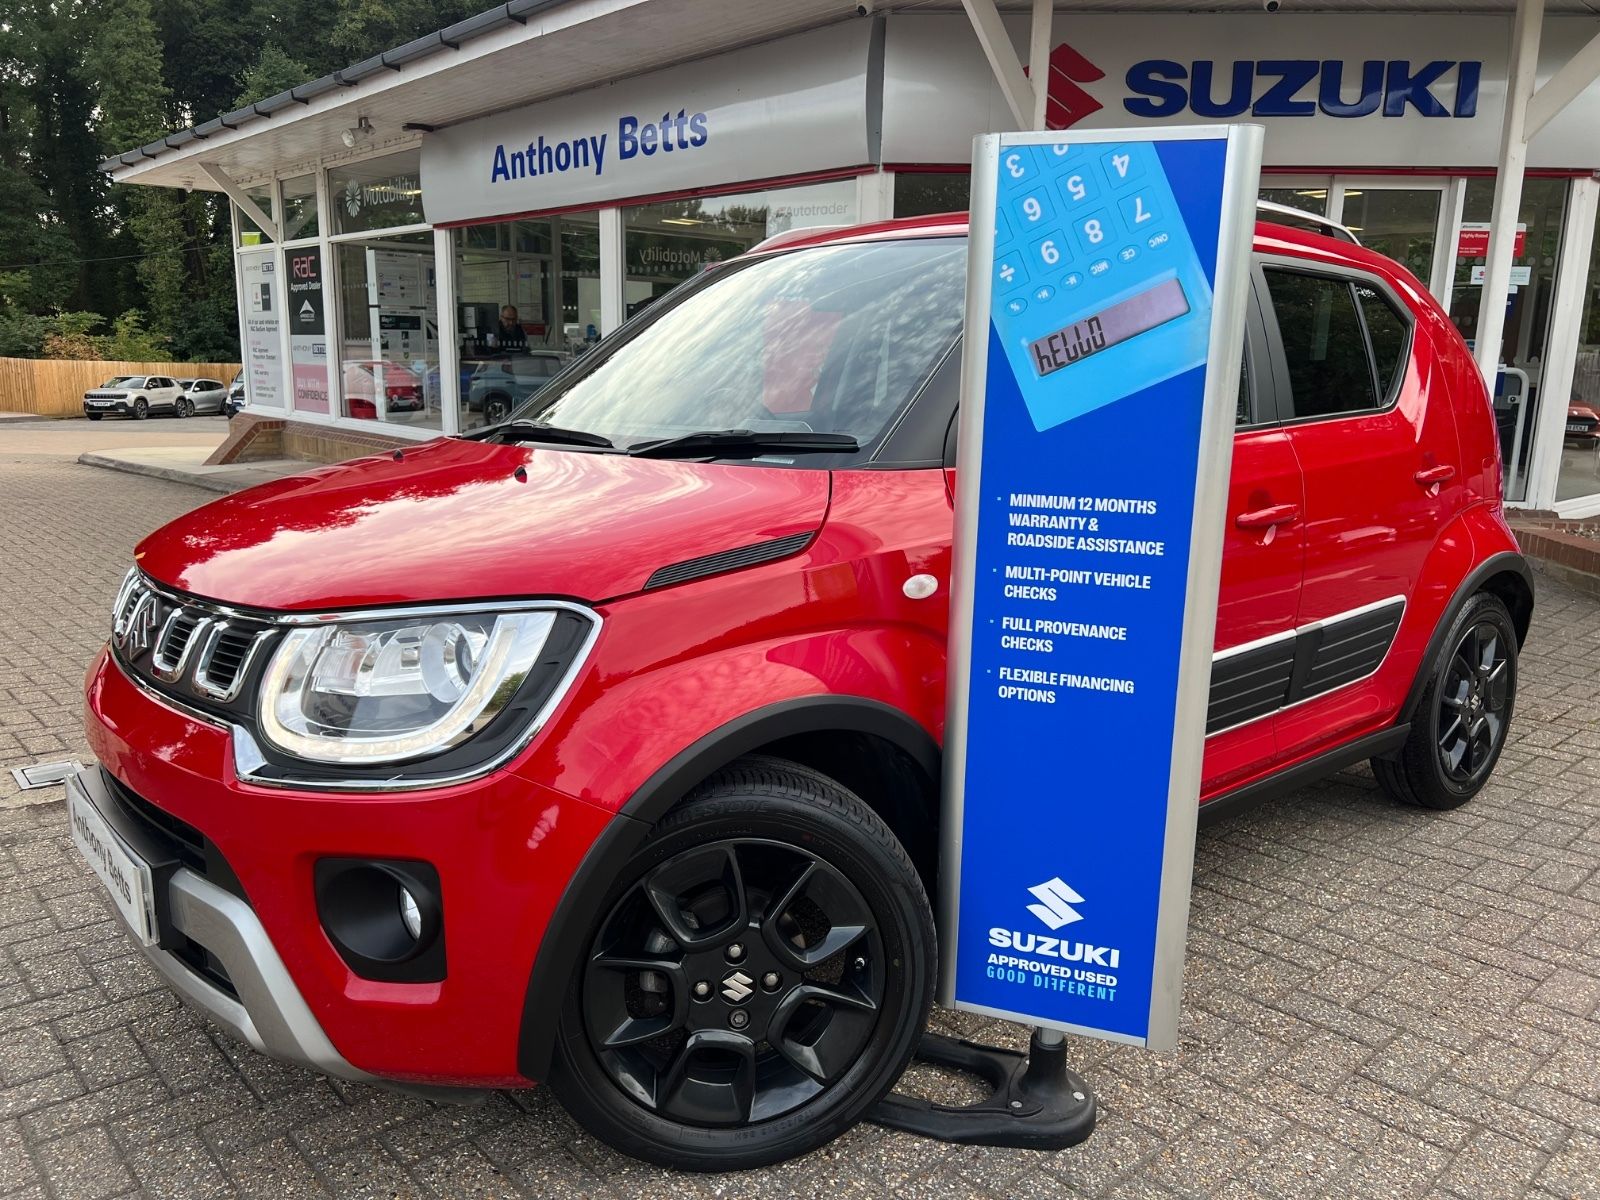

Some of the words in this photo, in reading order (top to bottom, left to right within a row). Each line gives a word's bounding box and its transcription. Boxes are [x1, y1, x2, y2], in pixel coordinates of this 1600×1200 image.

[1123, 59, 1482, 119] SUZUKI
[492, 134, 607, 183] Anthony
[619, 108, 708, 161] Betts
[1006, 154, 1024, 178] 3
[1112, 154, 1130, 178] 4
[363, 176, 417, 207] Motability
[1067, 175, 1086, 201] 5
[785, 201, 849, 217] Autotrader
[1023, 197, 1042, 221] 6
[1135, 197, 1151, 224] 7
[1084, 219, 1104, 244] 8
[1010, 493, 1076, 510] MINIMUM
[1078, 497, 1092, 510] 12
[1094, 498, 1156, 514] MONTHS
[1009, 513, 1086, 530] WARRANTY
[1088, 518, 1099, 532] &
[1008, 532, 1075, 550] ROADSIDE
[1076, 537, 1164, 556] ASSISTANCE
[1006, 565, 1092, 584] MULTI-POINT
[1094, 572, 1151, 589] VEHICLE
[1004, 585, 1056, 602] CHECKS
[1002, 616, 1033, 632] FULL
[1035, 620, 1127, 640] PROVENANCE
[1001, 636, 1054, 652] CHECKS
[1000, 667, 1058, 686] FLEXIBLE
[1060, 674, 1134, 694] FINANCING
[998, 686, 1056, 704] OPTIONS
[72, 801, 106, 872] Anthony
[107, 848, 132, 904] Betts
[988, 928, 1120, 968] SUZUKI
[988, 954, 1072, 978] APPROVED
[1074, 970, 1118, 986] USED
[986, 966, 1026, 984] GOOD
[1034, 974, 1116, 1002] DIFFERENT
